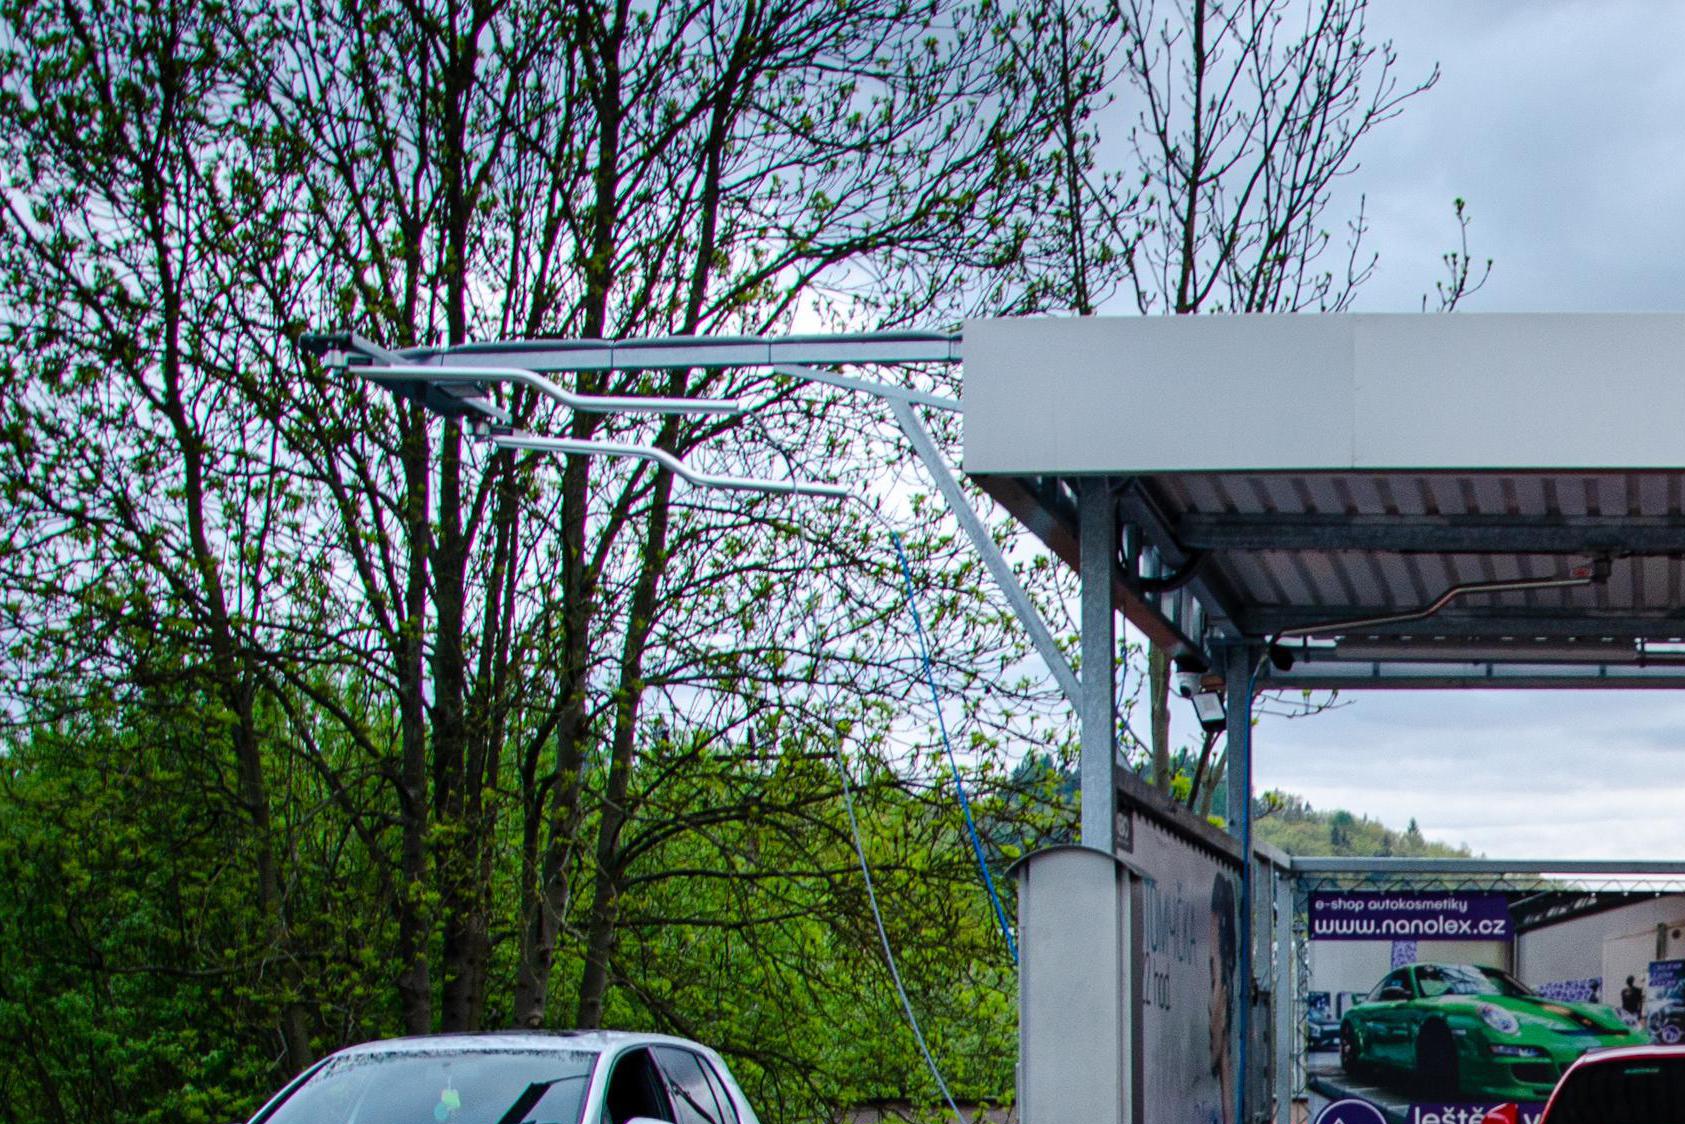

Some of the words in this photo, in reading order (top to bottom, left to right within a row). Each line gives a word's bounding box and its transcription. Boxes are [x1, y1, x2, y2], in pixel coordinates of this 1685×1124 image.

[1315, 898, 1364, 912] e-shop
[1368, 898, 1468, 913] autokosmetiky
[1314, 915, 1506, 934] www.nanolex.cz
